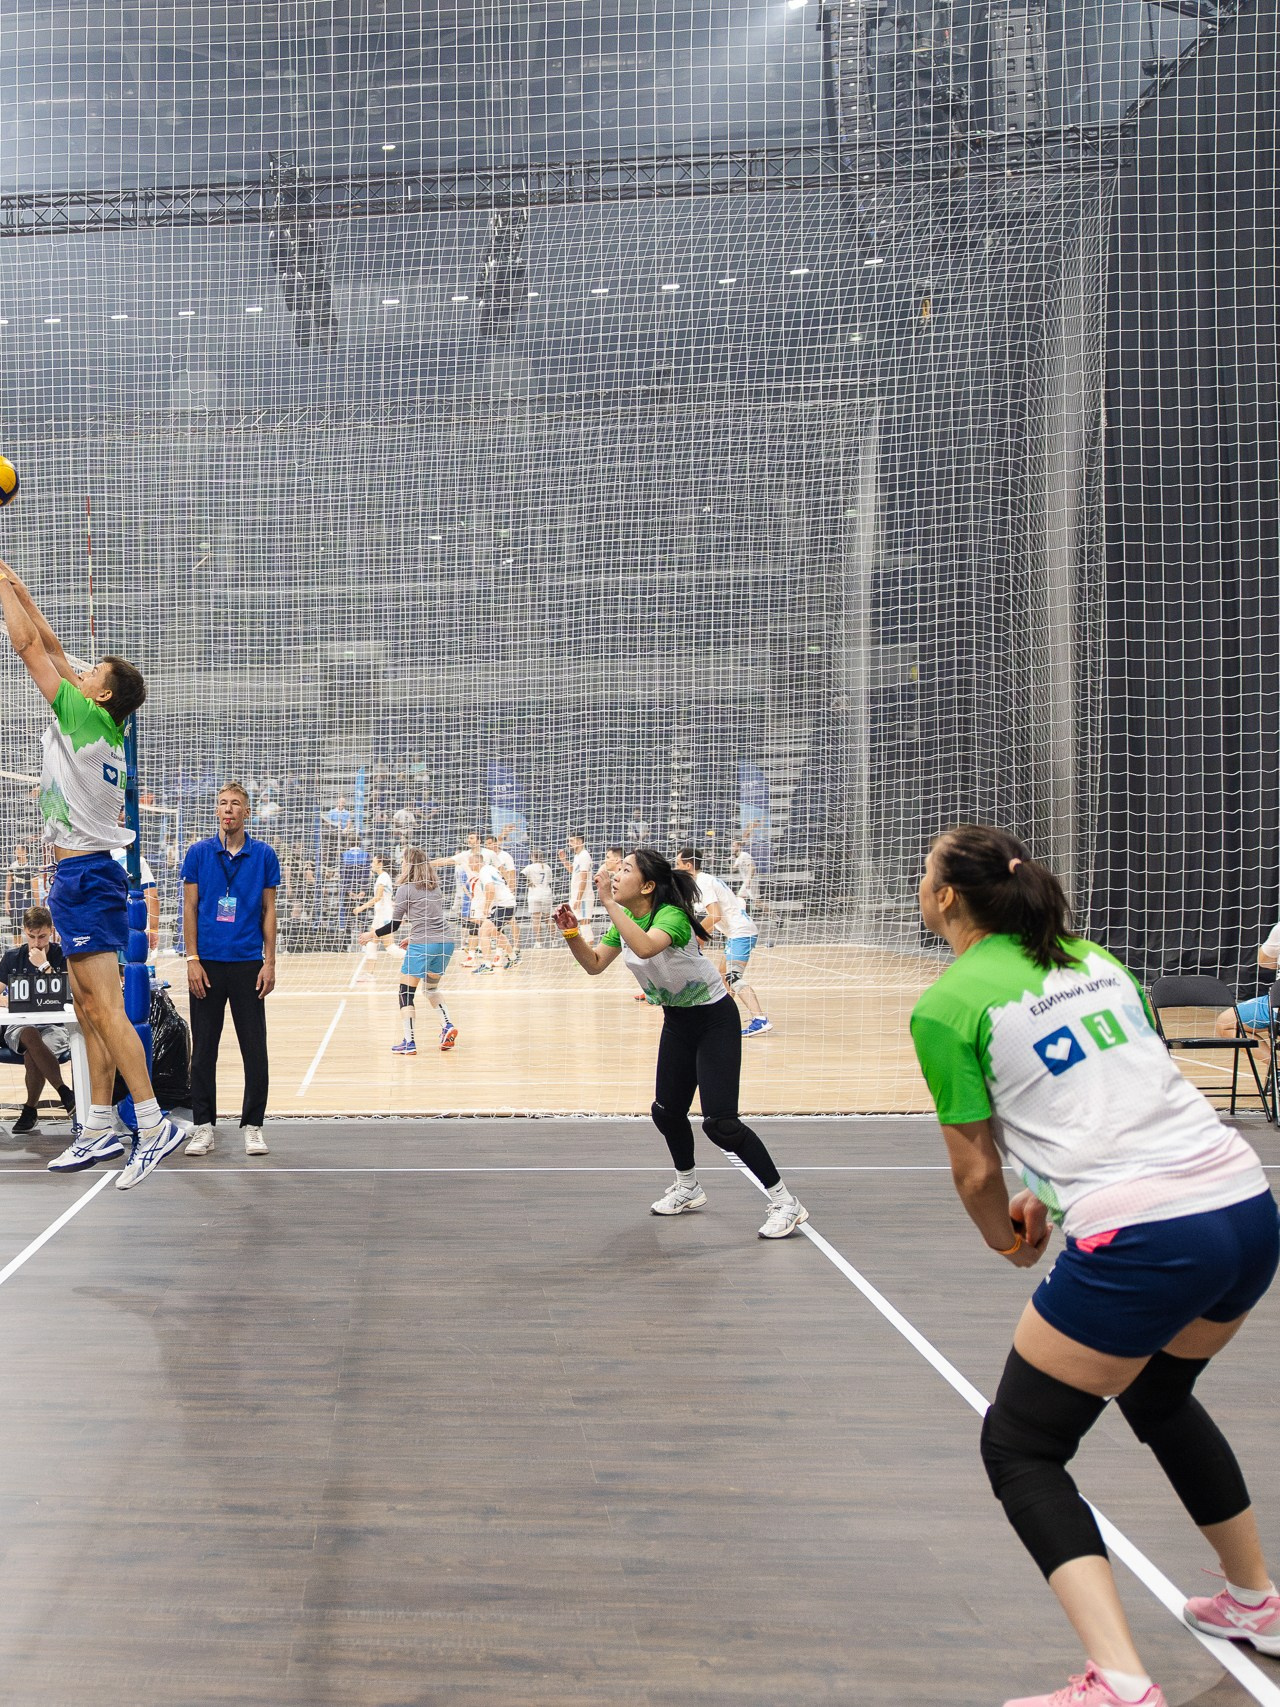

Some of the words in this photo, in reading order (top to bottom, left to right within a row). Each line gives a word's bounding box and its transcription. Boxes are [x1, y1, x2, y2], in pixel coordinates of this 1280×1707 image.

[11, 979, 30, 1000] 10
[36, 979, 46, 993] 0
[51, 978, 61, 993] 0
[1030, 984, 1085, 1016] ЕДИНЫЙ
